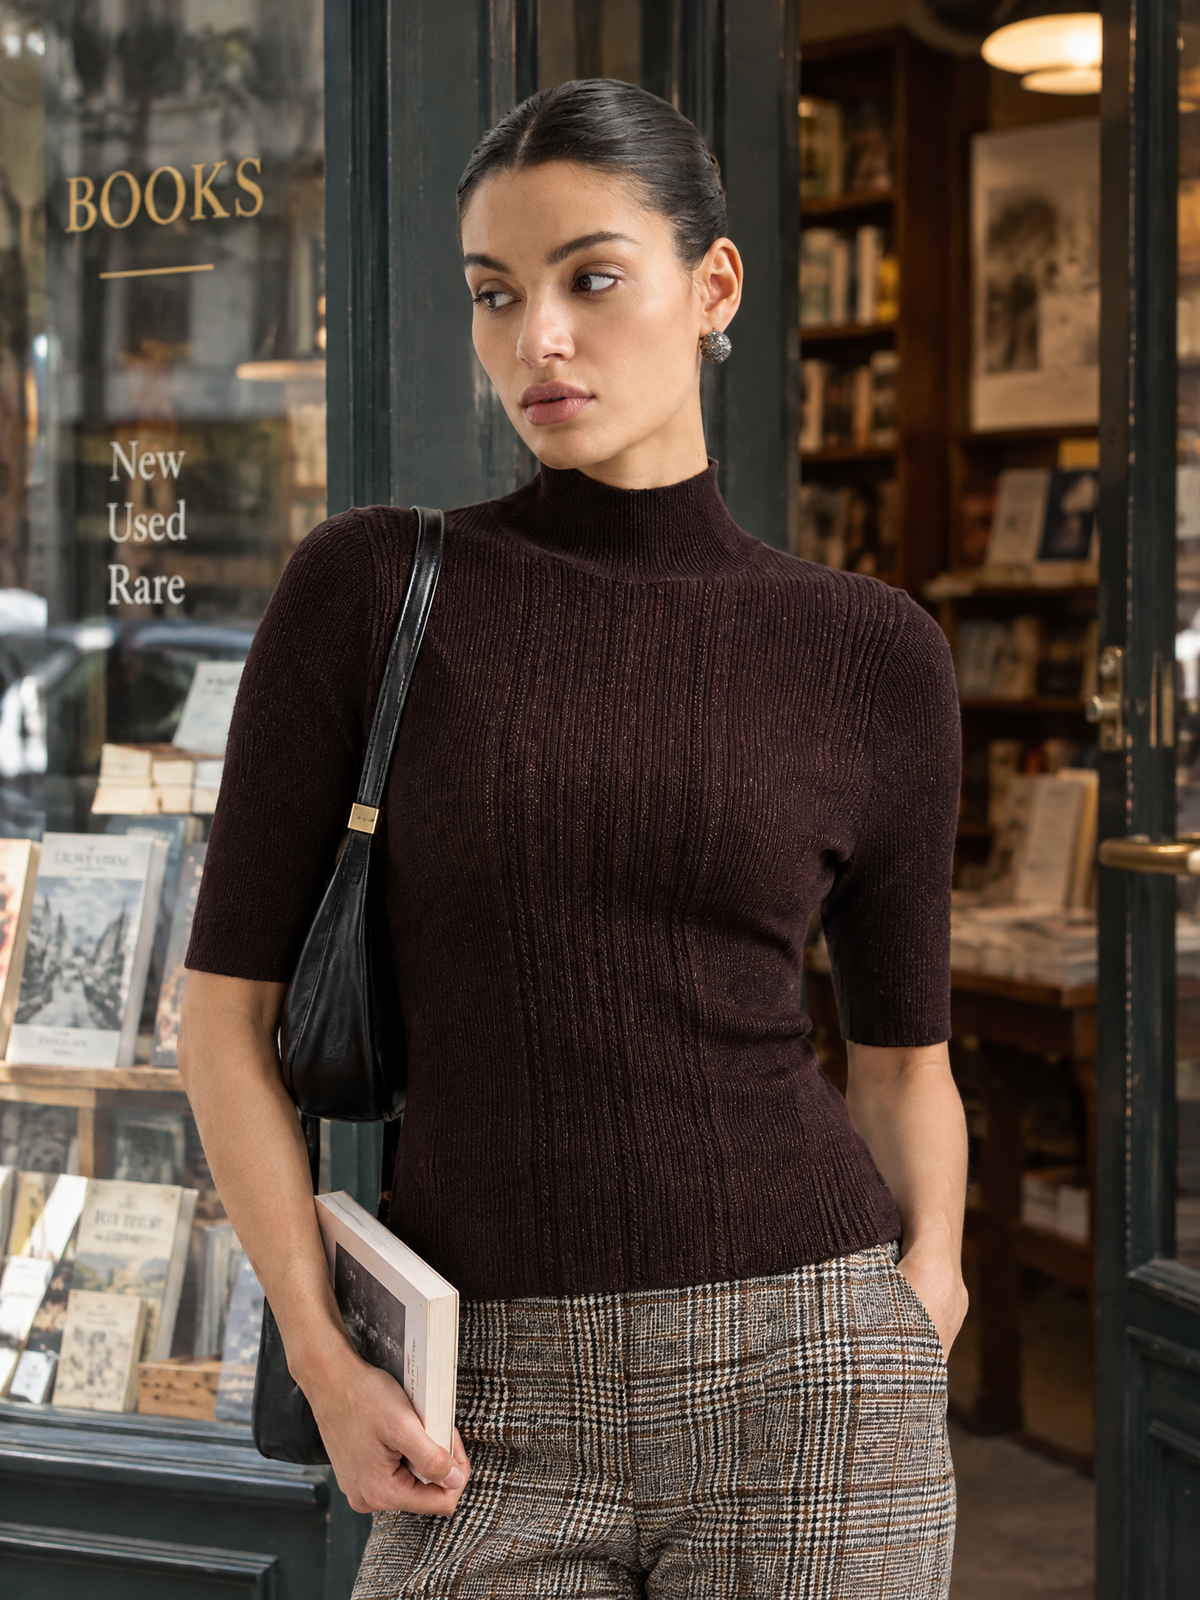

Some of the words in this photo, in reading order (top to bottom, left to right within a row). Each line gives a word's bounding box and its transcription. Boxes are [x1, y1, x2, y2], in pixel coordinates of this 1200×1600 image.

[65, 157, 264, 233] BOOKS
[109, 440, 186, 482] New
[107, 499, 188, 543] Used
[108, 563, 186, 605] Rare
